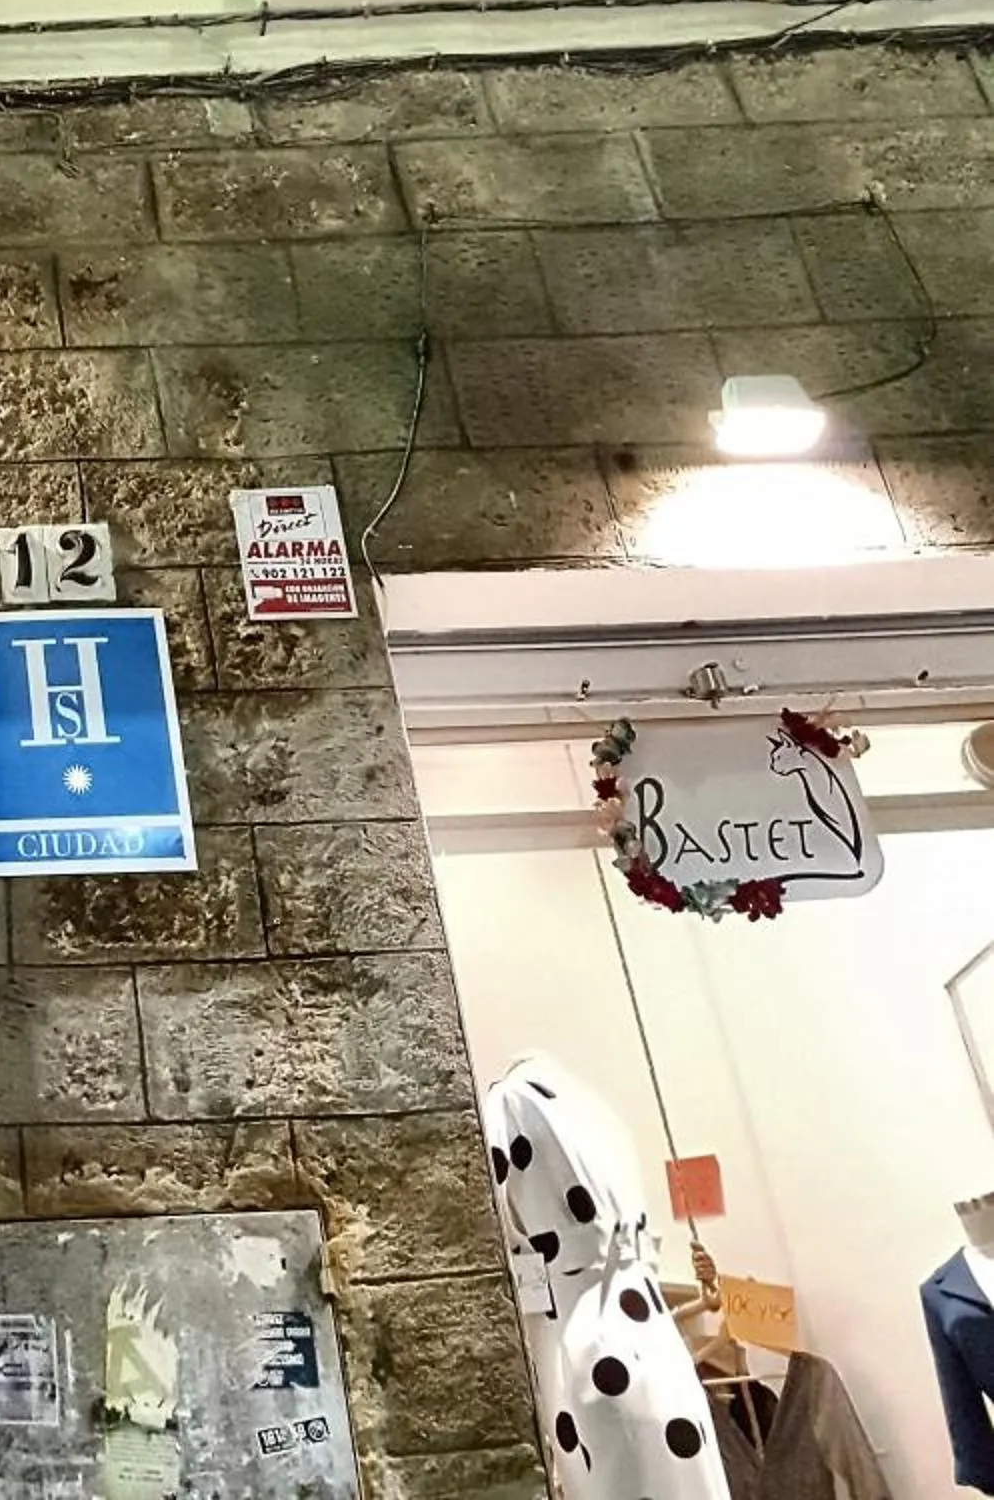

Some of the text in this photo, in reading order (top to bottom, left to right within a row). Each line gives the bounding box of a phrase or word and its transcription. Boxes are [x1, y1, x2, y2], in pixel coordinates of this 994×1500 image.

[247, 540, 343, 558] ALARMA
[7, 530, 101, 593] 12
[262, 566, 346, 579] 902 121 122
[17, 828, 145, 858] CIUDAD
